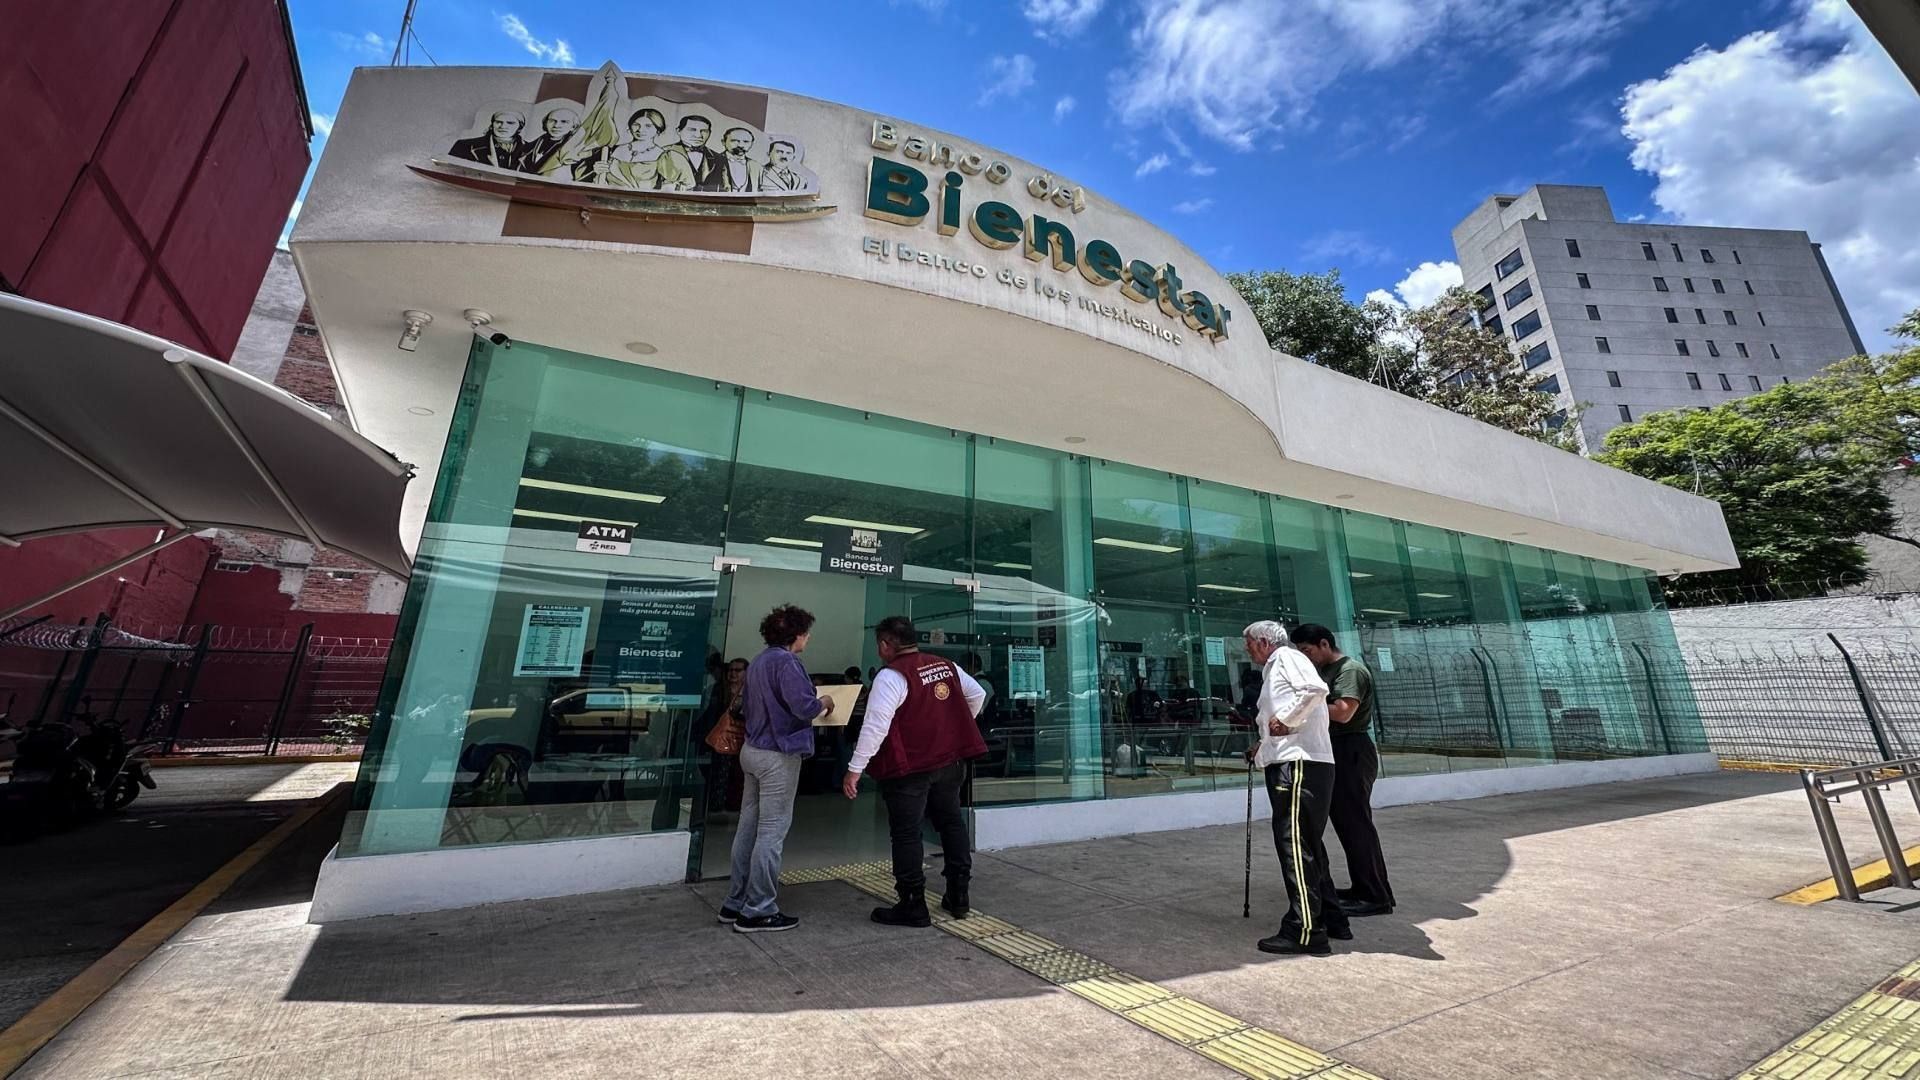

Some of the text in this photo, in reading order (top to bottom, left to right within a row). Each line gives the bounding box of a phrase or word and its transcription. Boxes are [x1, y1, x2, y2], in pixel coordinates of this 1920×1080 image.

[872, 119, 1086, 214] Banco del
[864, 156, 1232, 343] Bienestar
[863, 235, 1183, 345] El banco de los mexicanos
[586, 526, 626, 538] ATM
[830, 557, 895, 573] Bienestar
[845, 553, 869, 561] Banco
[620, 586, 701, 598] BIENVENIDOS
[619, 647, 684, 658] Bienestar
[921, 670, 954, 686] MÉXICO
